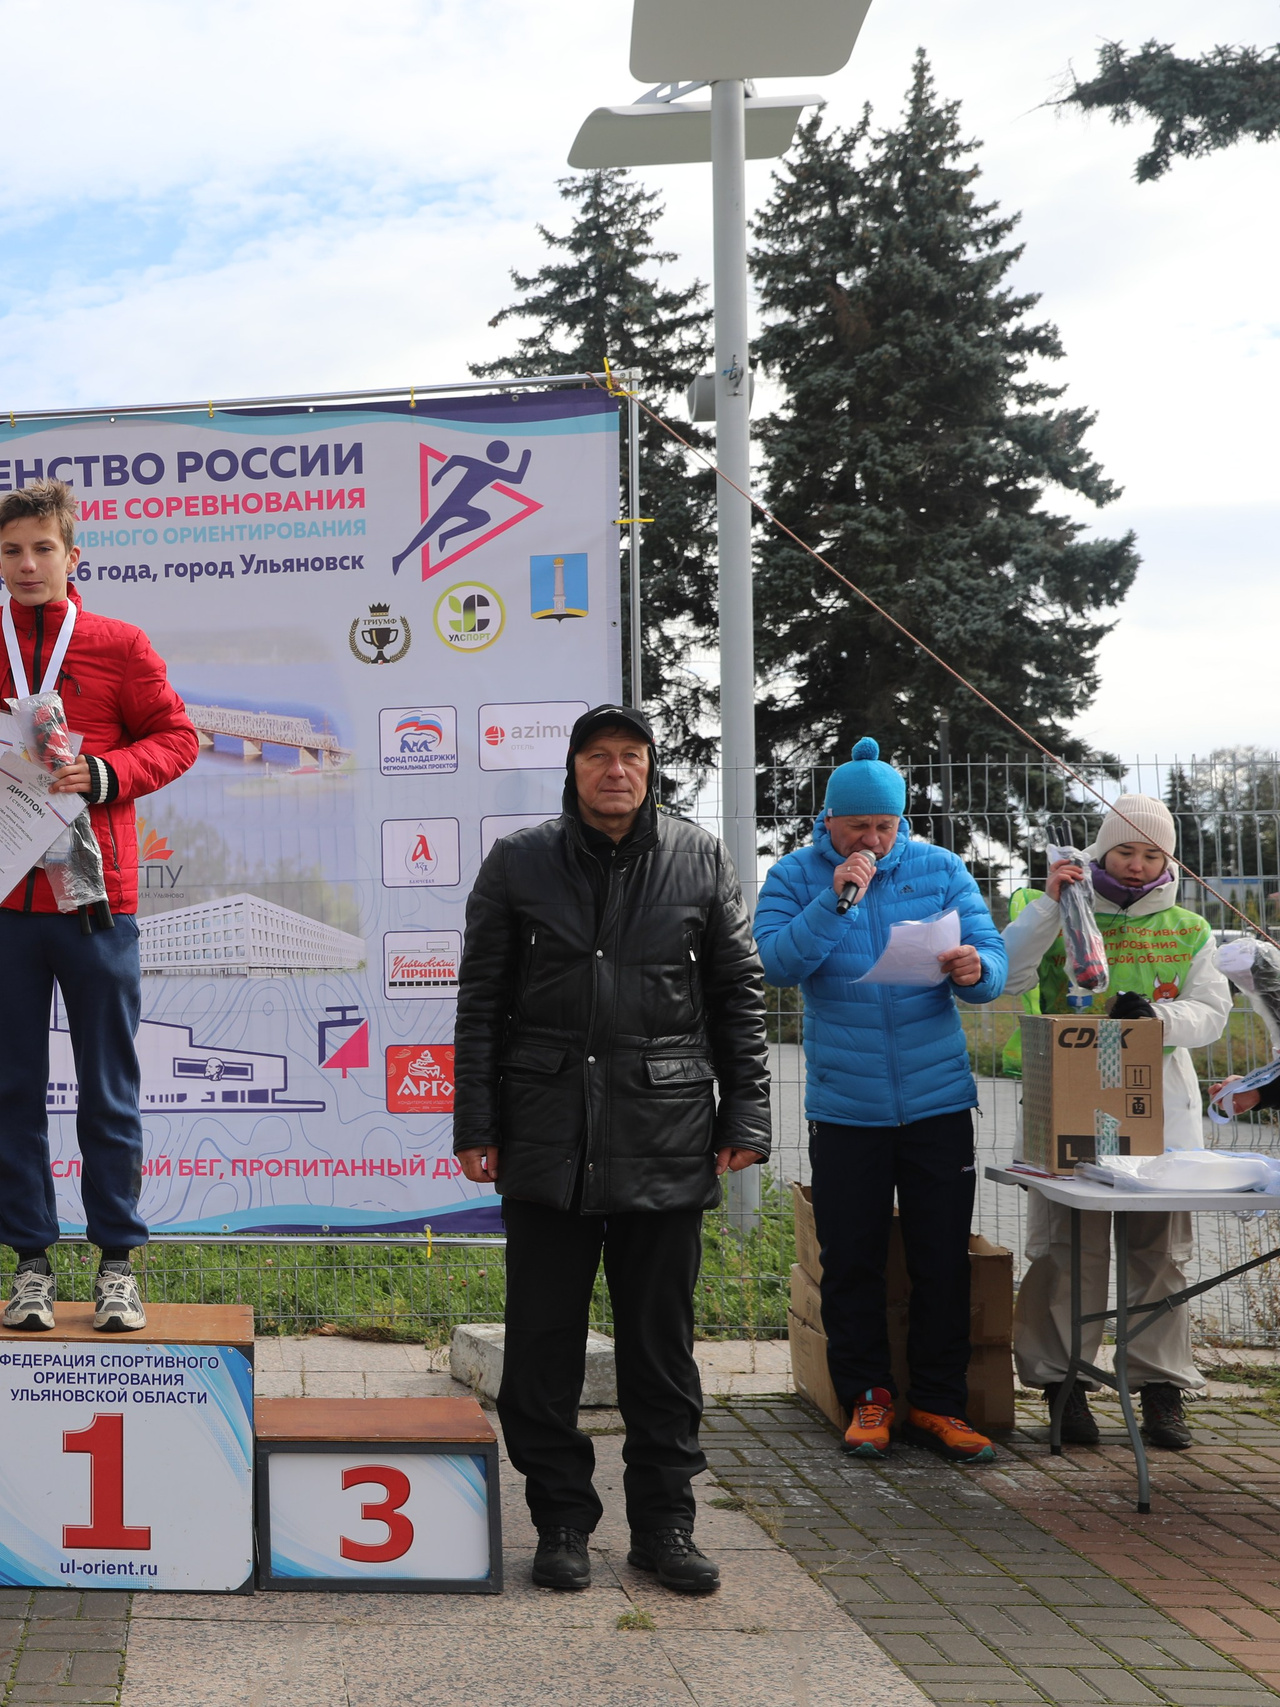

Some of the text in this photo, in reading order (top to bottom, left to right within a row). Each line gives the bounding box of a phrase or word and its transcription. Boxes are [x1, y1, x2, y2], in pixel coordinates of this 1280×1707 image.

[177, 442, 364, 483] РОССИИ
[125, 488, 366, 519] СОРЕВНОВАНИЯ
[163, 519, 367, 545] ОРИЕНТИРОВАНИЯ
[98, 564, 158, 583] года,
[164, 561, 235, 583] город
[239, 553, 365, 575] Ульяновск
[362, 617, 397, 626] ТРИУМФ
[448, 633, 491, 642] УЛСПОРТ
[511, 721, 574, 739] azimu
[383, 754, 456, 764] ФОНД ПОДДЕРЖКИ
[7, 784, 46, 819] ДИПЛОМ
[401, 968, 456, 979] ПРЯНИК
[178, 1158, 225, 1179] БЕГ,
[231, 1154, 426, 1177] ПРОПИТАННЫЙ
[0, 1353, 219, 1369] ФЕДЕРАЦИЯ СПОРТИВНОГО
[33, 1371, 184, 1386] ОРИЕНТИРОВАНИЯ
[10, 1387, 208, 1404] УЛЬЯНОВСКОЙ ОБЛАСТИ
[62, 1412, 151, 1550] 1
[340, 1464, 414, 1563] 3
[60, 1559, 158, 1576] ul-orient.ru
